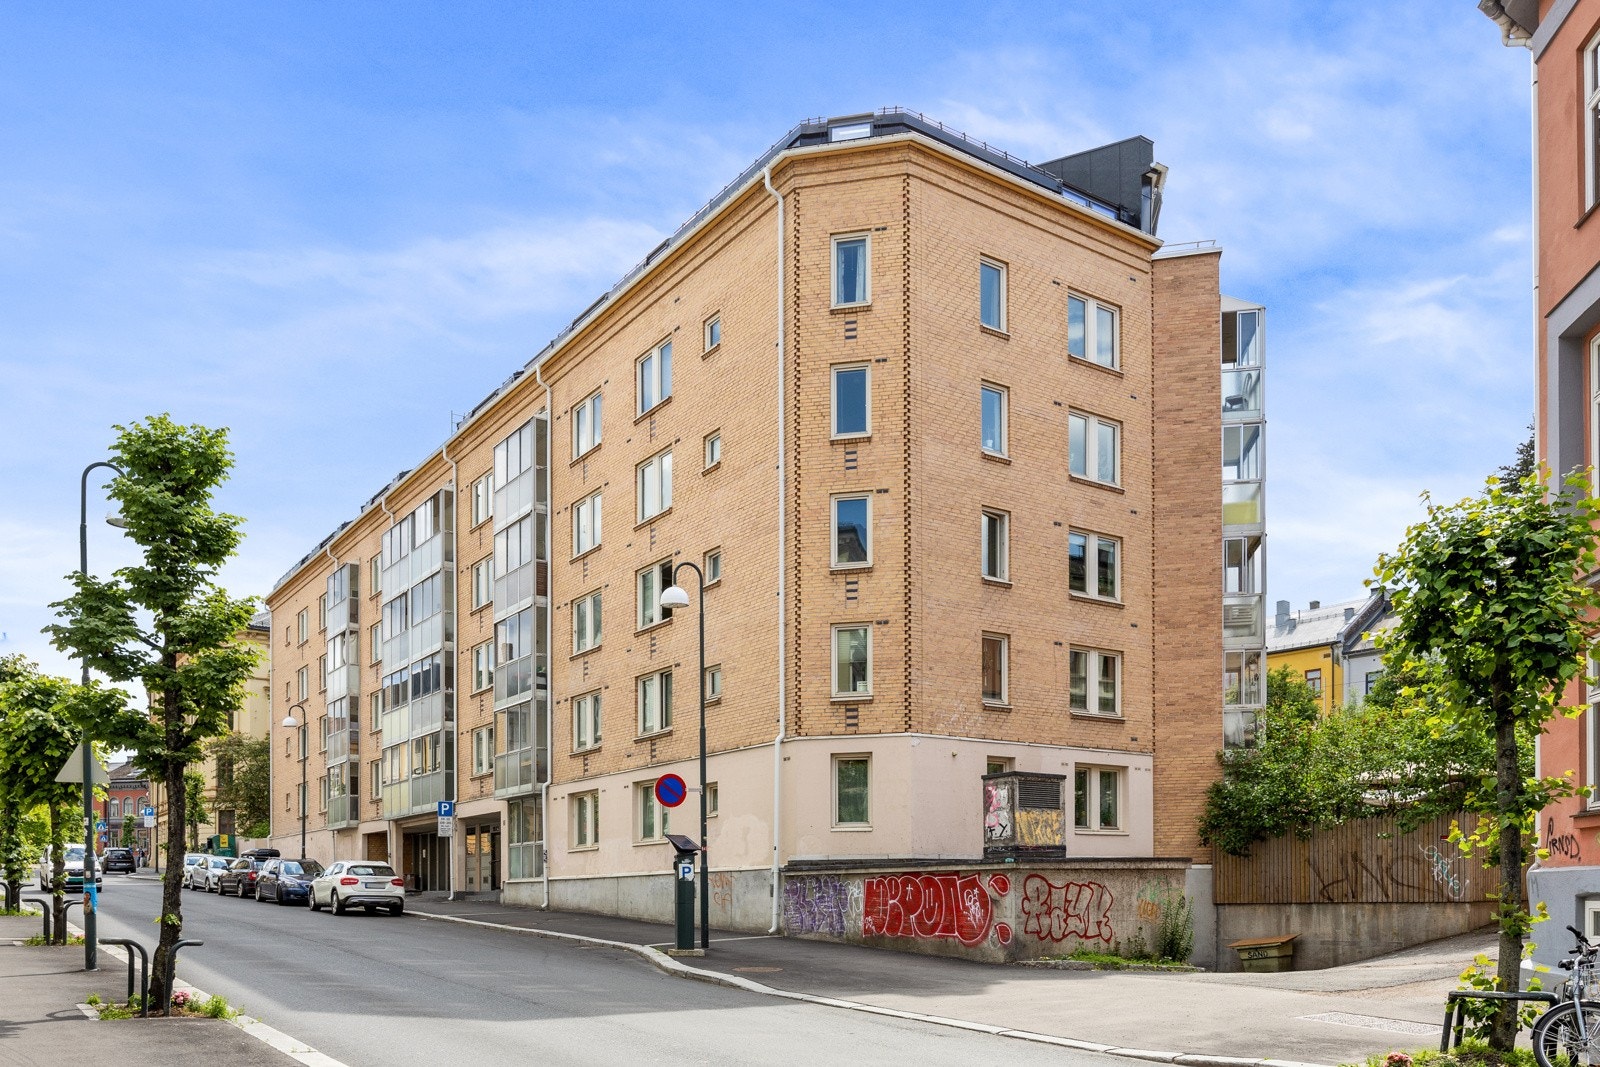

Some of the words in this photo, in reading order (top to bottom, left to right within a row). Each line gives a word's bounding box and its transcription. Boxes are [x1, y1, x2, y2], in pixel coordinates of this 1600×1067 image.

[146, 808, 152, 816] P
[441, 803, 450, 815] P
[682, 866, 692, 880] P
[1247, 950, 1269, 959] SAND
